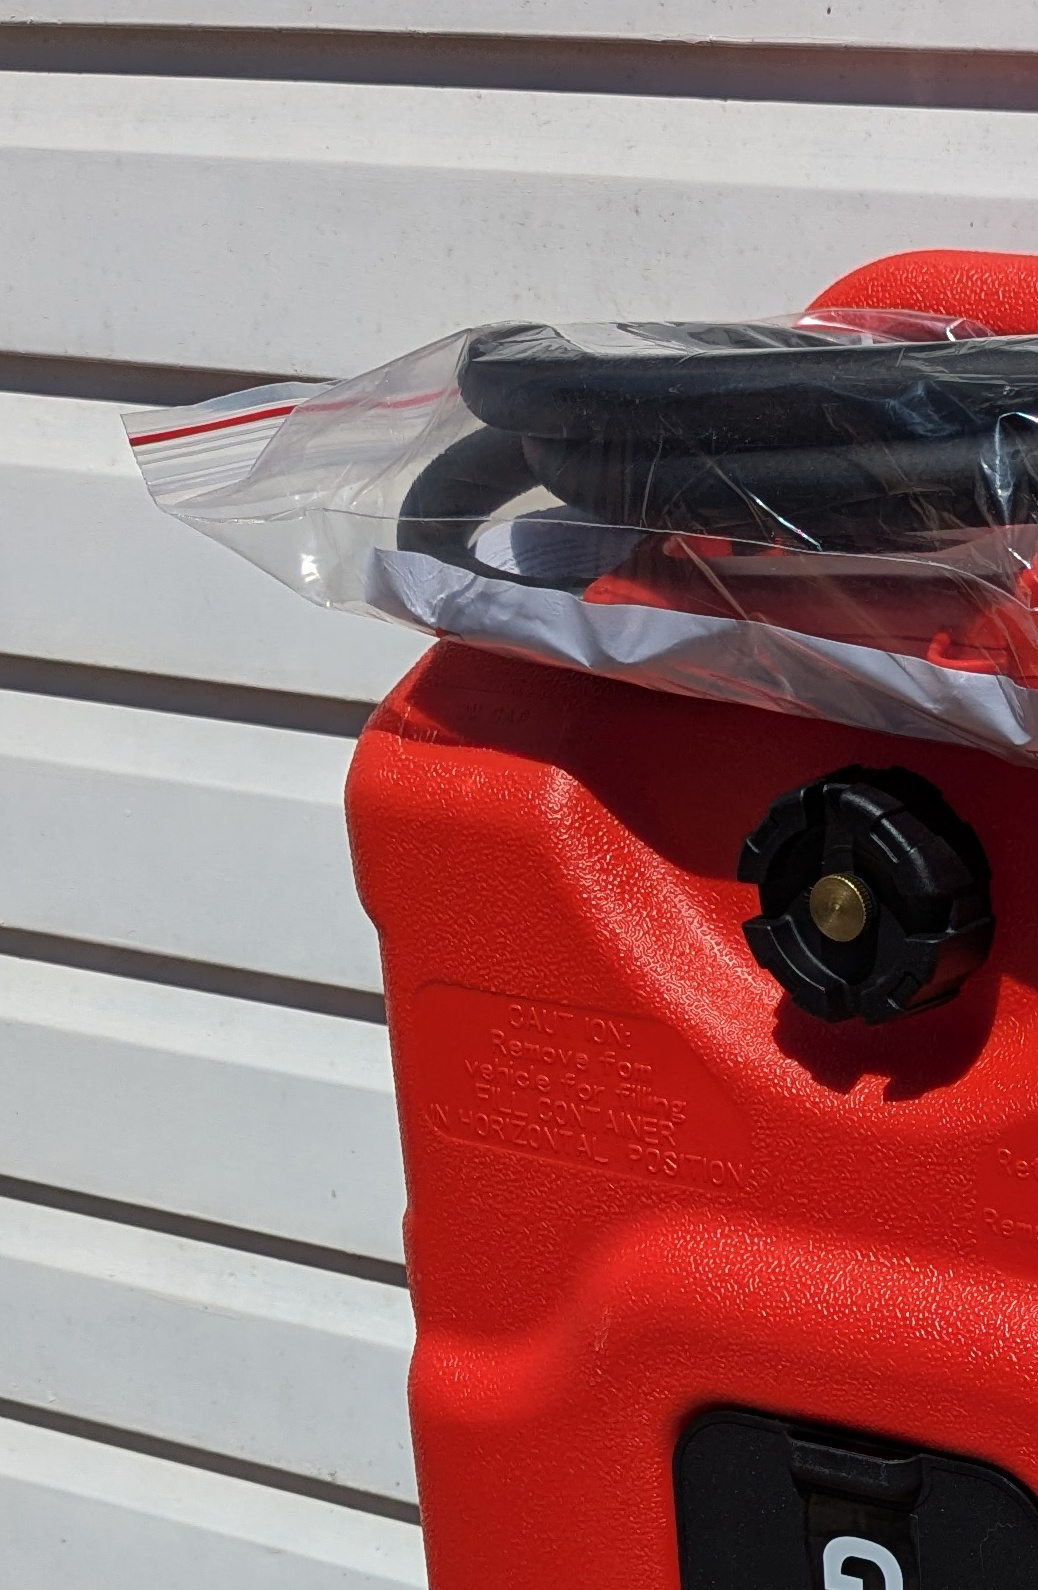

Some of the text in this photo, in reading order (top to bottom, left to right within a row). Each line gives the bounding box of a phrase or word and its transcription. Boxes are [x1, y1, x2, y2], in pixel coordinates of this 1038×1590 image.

[508, 1003, 631, 1049] CAUTION:
[490, 1028, 590, 1072] Remove
[464, 1058, 551, 1094] vehicle
[561, 1072, 605, 1103] for
[475, 1083, 676, 1147] FILL CONTAINER
[458, 1108, 609, 1163] HORIZONTAL
[627, 1143, 745, 1188] POSITION
